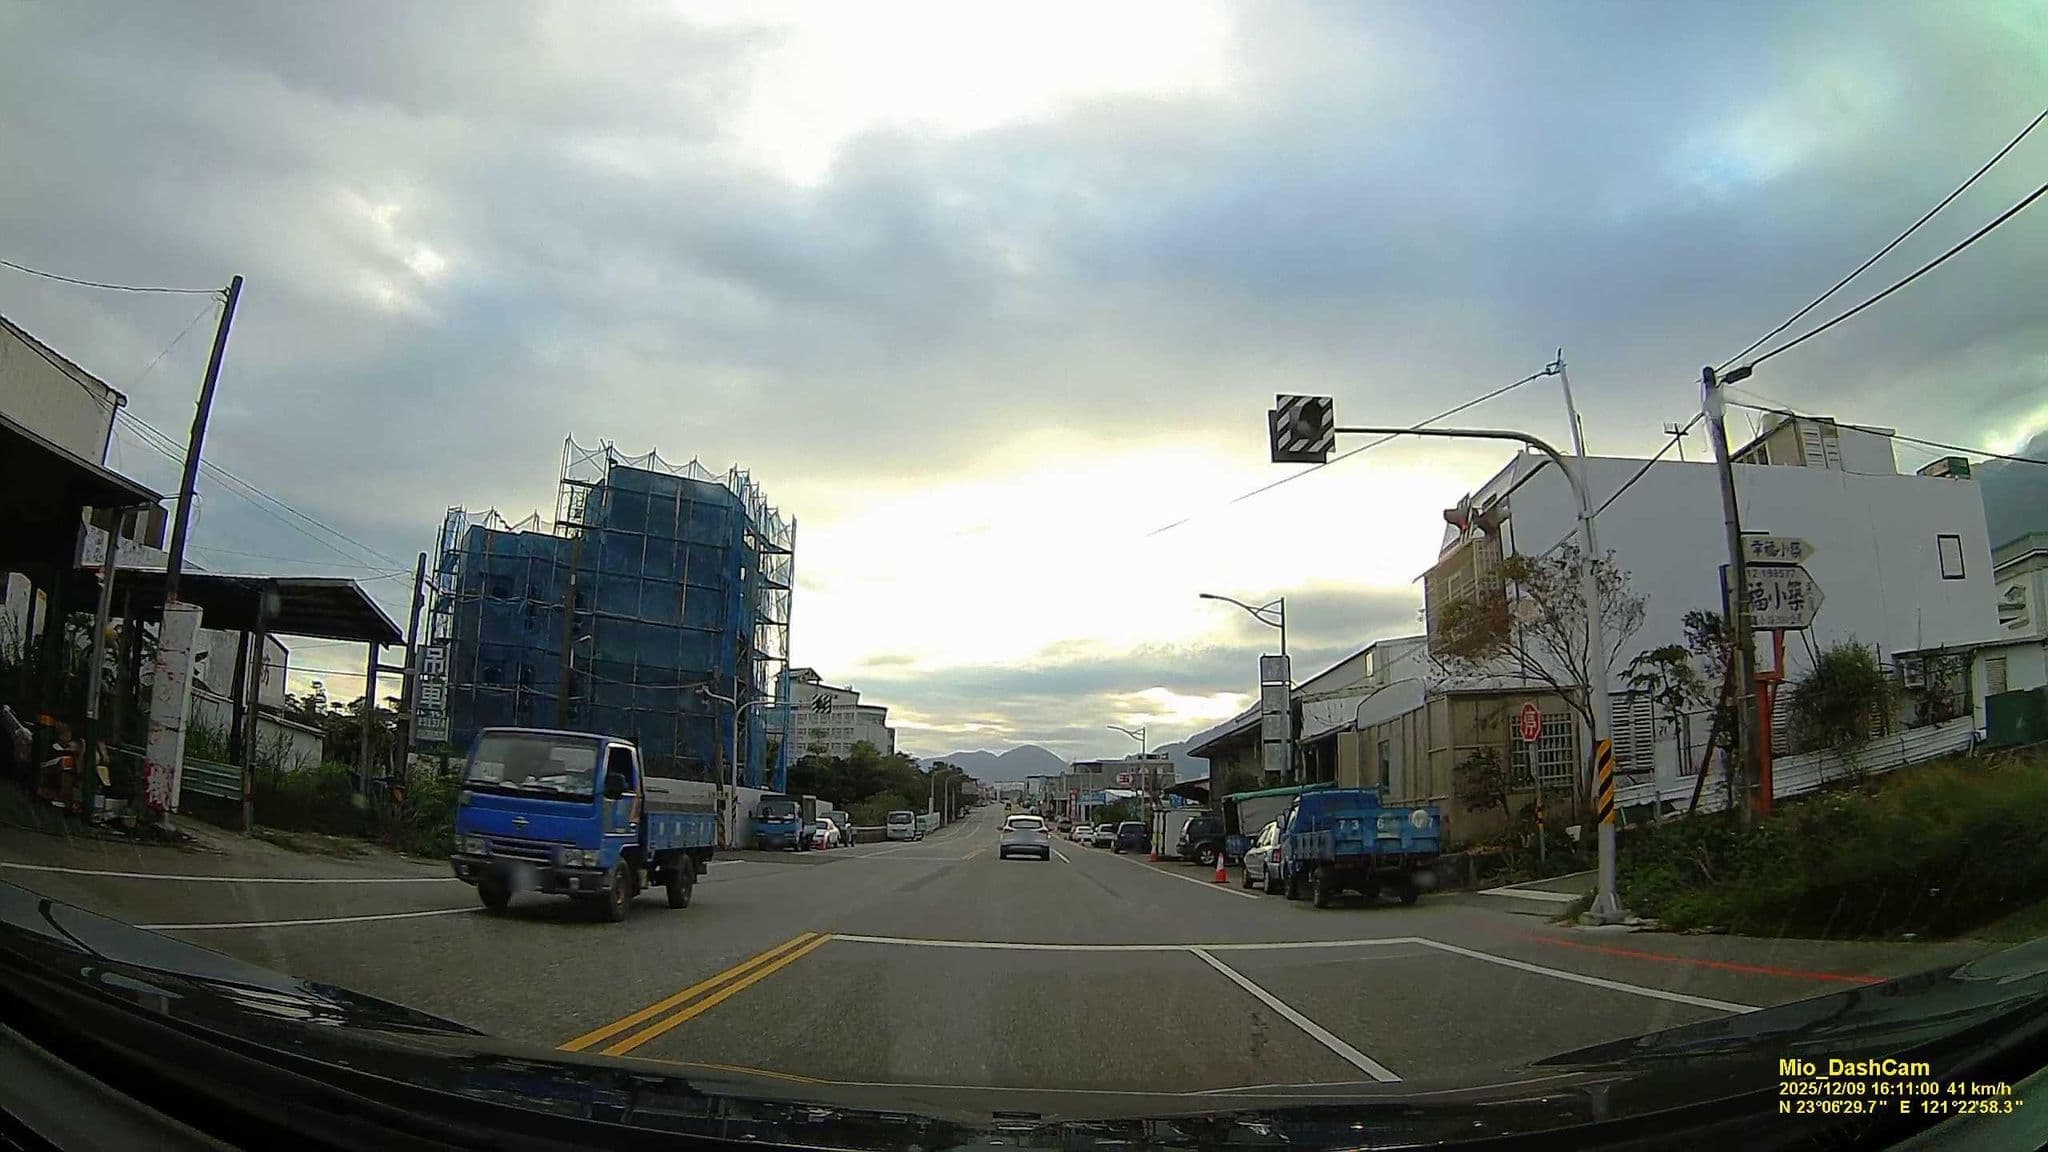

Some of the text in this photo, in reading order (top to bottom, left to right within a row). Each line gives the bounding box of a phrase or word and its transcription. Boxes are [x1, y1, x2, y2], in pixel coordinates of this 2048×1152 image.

[1747, 580, 1806, 612] 福小築
[419, 647, 446, 709] 吊車
[1523, 704, 1538, 737] 停
